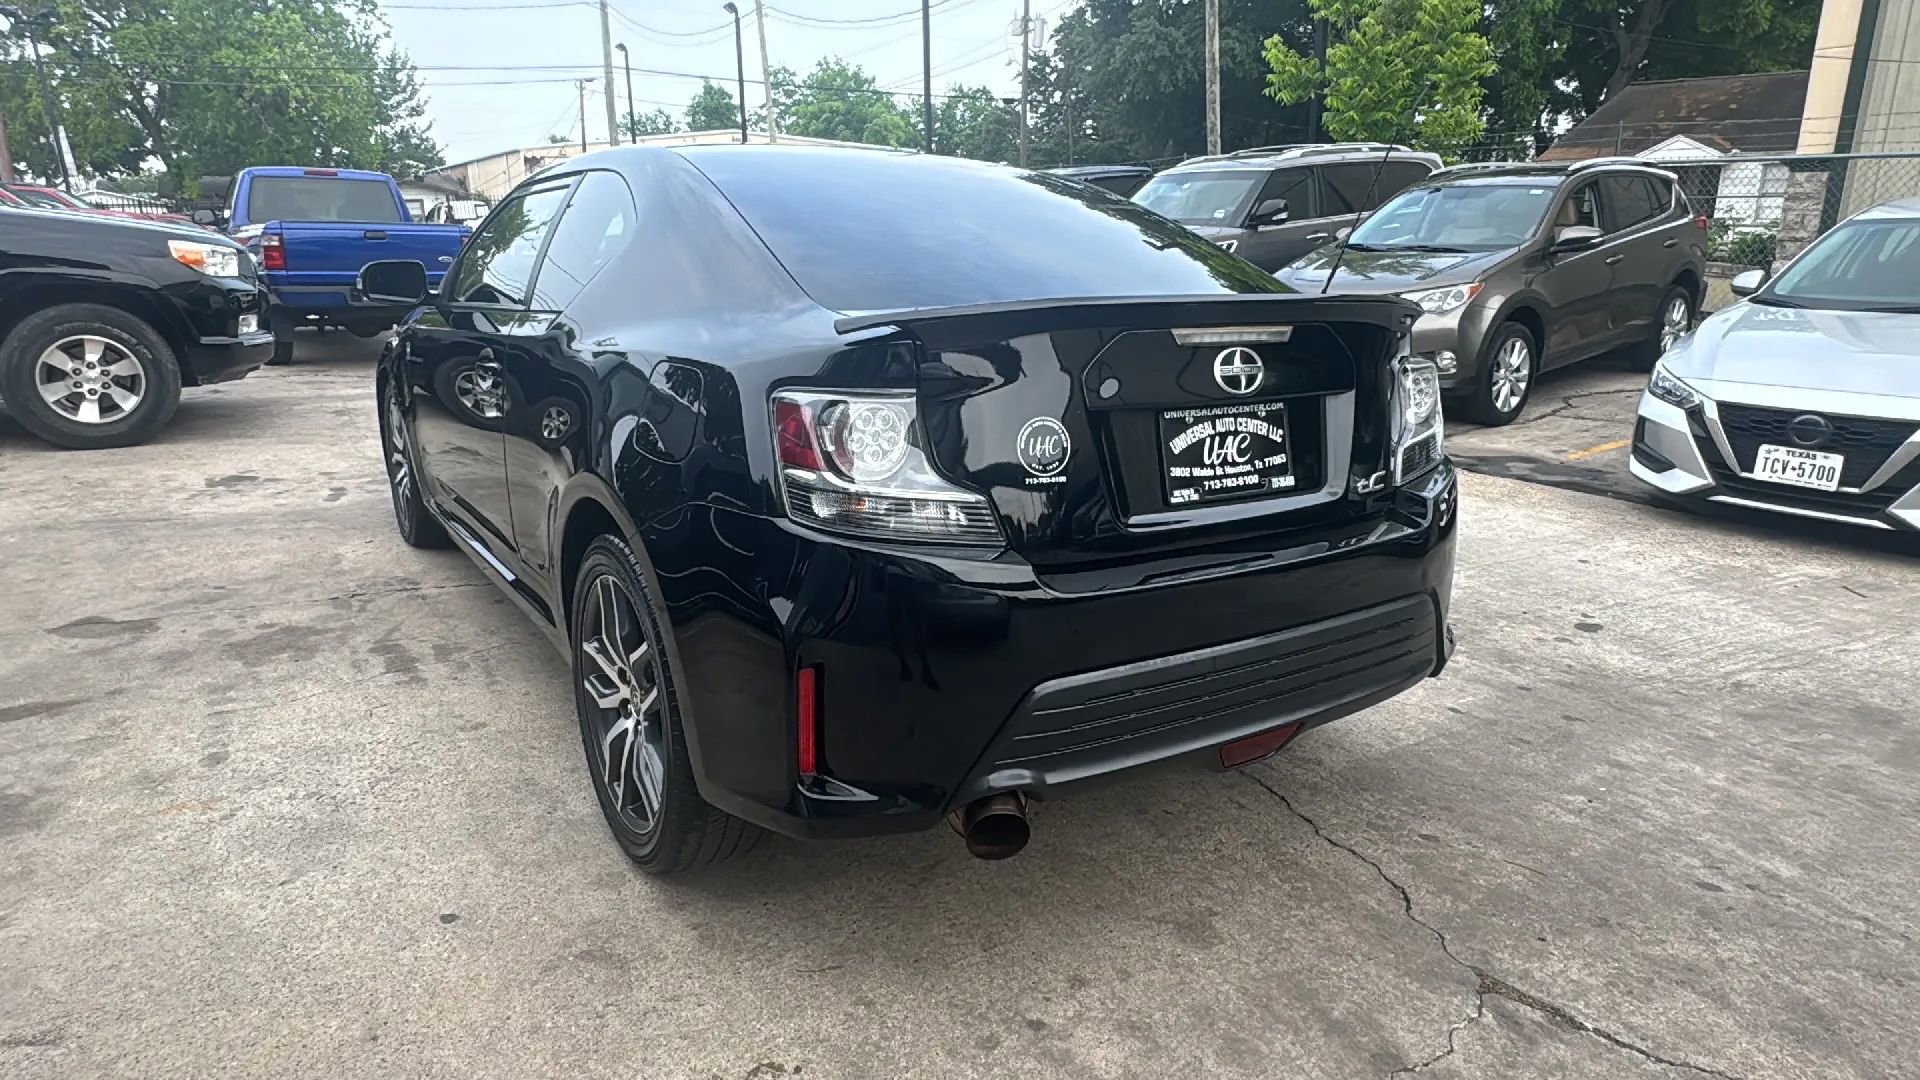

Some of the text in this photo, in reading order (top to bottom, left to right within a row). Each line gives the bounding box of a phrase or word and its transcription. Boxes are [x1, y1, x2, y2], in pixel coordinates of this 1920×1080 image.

[1164, 402, 1284, 419] UNIVERSALAUTOCENTER.COM
[1169, 417, 1284, 454] UNIVERSAL AUTO CENTER LLC
[1203, 433, 1252, 465] UAC
[1786, 450, 1817, 460] TEXAS
